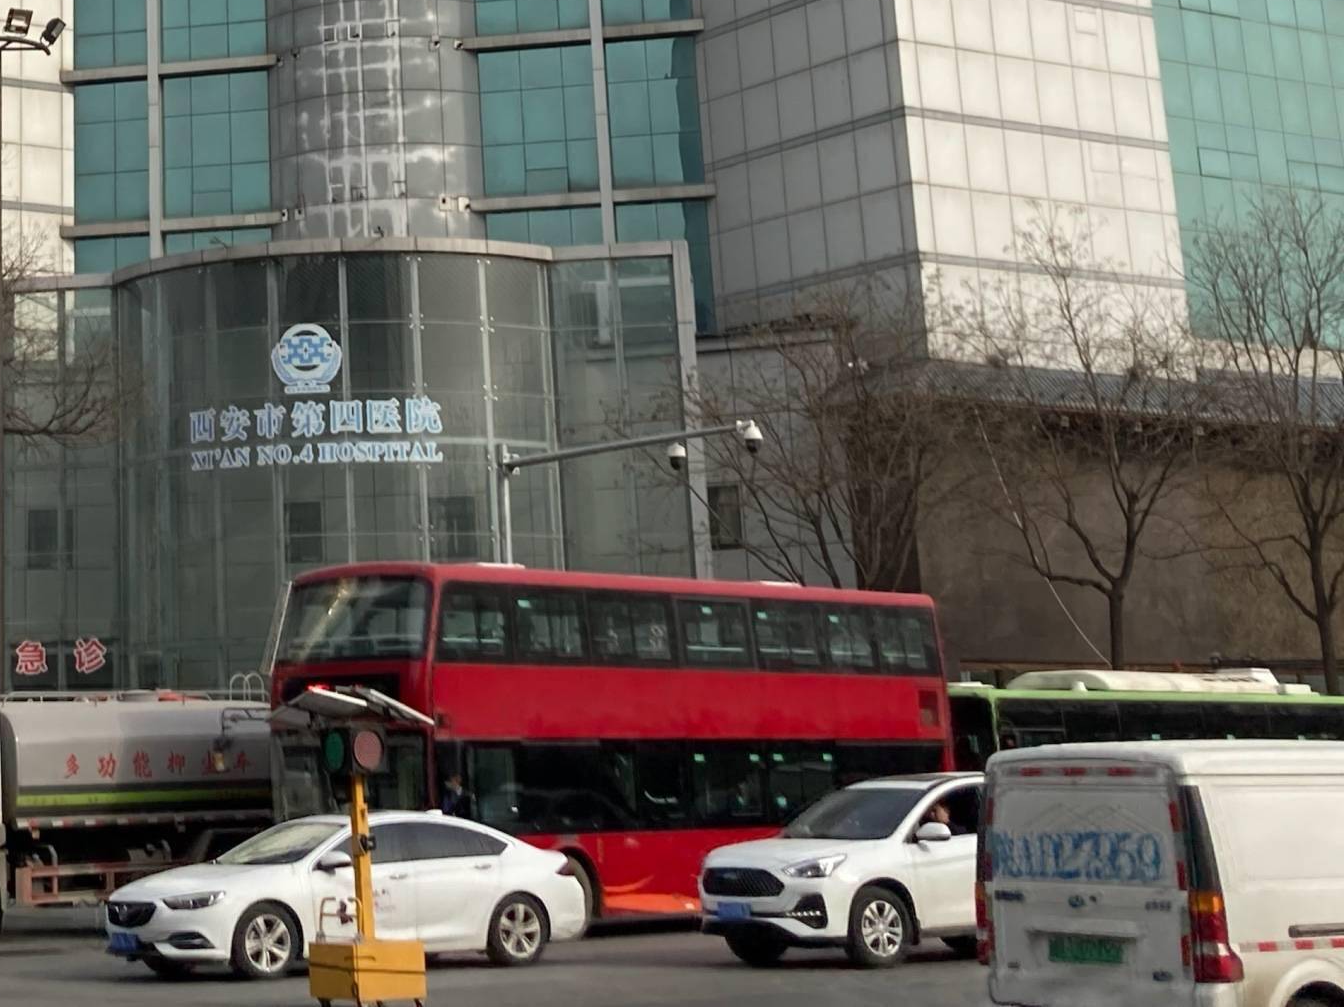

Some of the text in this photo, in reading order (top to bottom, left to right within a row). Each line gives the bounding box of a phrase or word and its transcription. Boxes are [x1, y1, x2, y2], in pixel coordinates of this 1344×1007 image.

[189, 396, 443, 443] 西安市第四医院
[257, 444, 313, 465] NO.4
[317, 442, 443, 464] HOSPITAL
[15, 637, 107, 675] 急诊
